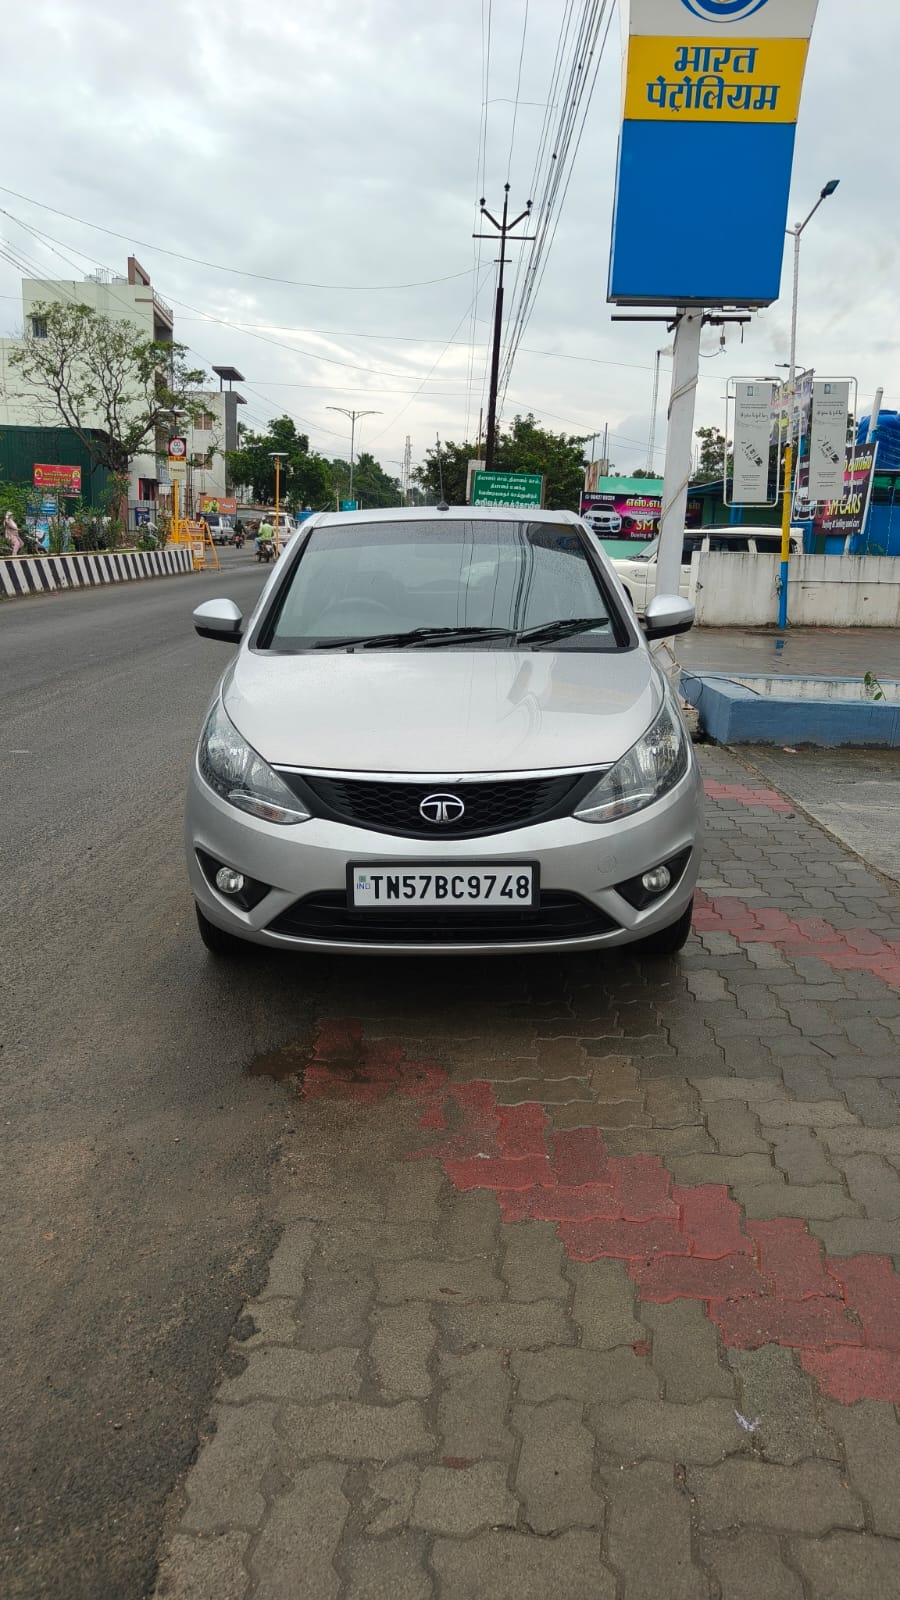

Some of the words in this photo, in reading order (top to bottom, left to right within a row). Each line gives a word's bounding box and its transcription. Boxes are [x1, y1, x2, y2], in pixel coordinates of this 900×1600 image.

[674, 46, 759, 73] भारत
[646, 75, 781, 112] पेट्रोलियम
[840, 493, 862, 515] CARS
[635, 519, 654, 531] SM
[370, 875, 530, 899] TN57BC9748
